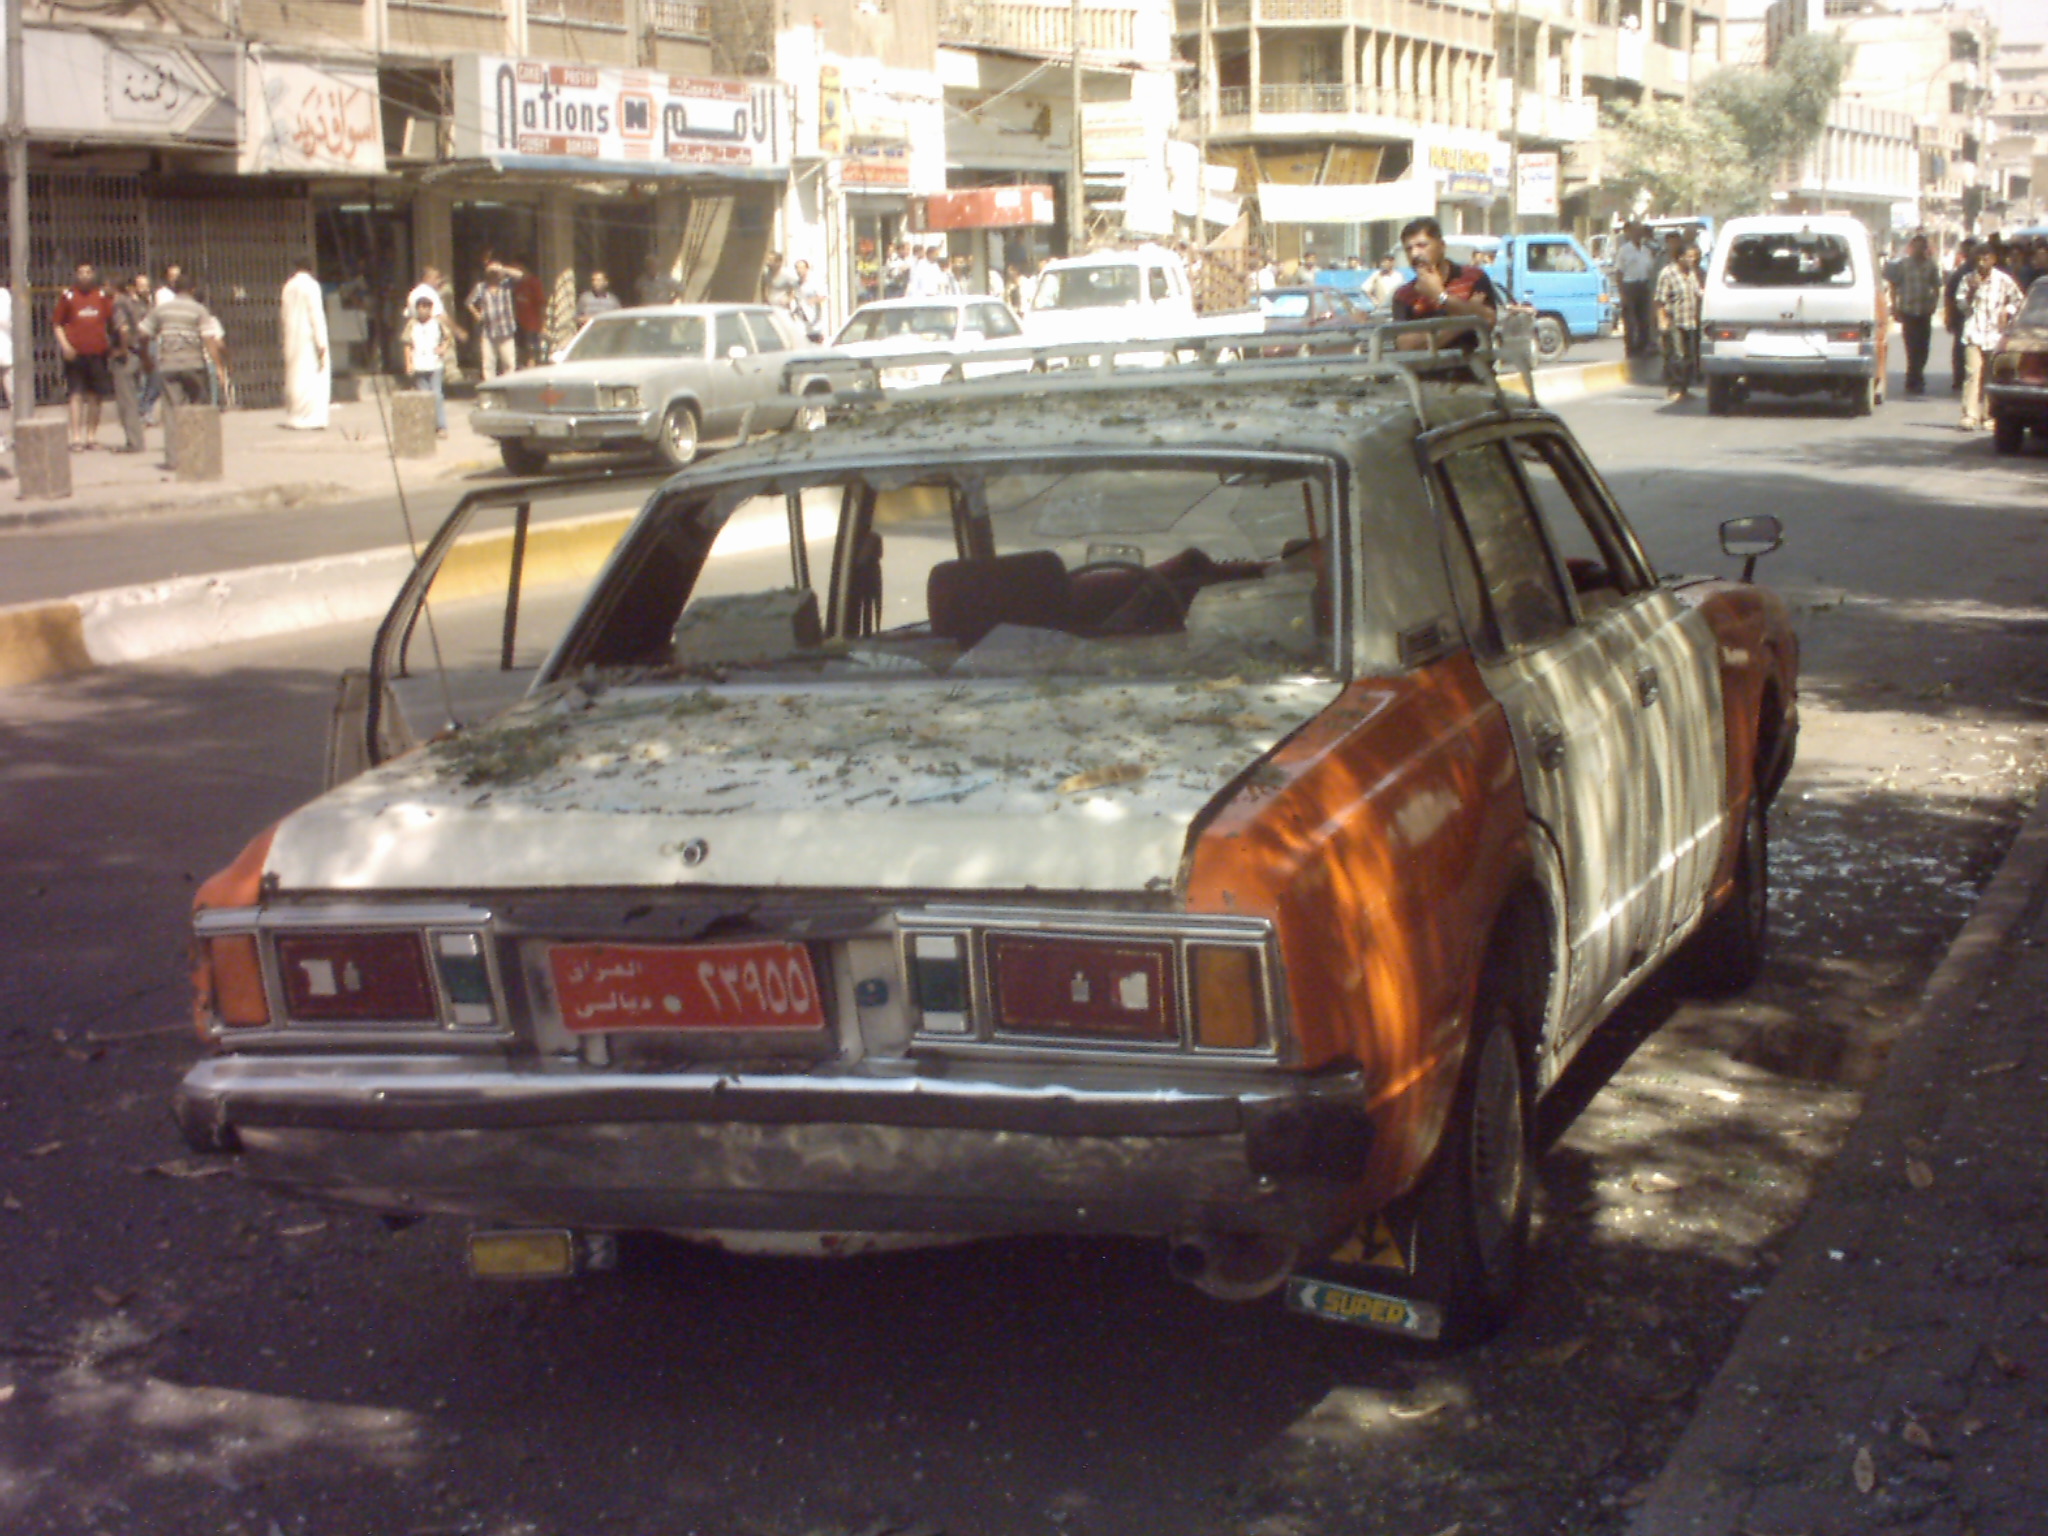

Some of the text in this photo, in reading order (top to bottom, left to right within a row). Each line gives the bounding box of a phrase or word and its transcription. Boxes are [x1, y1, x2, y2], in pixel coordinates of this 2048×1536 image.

[497, 62, 609, 150] Nations
[568, 959, 643, 984] العراق
[698, 957, 811, 1014] ٢٣٩٥٥
